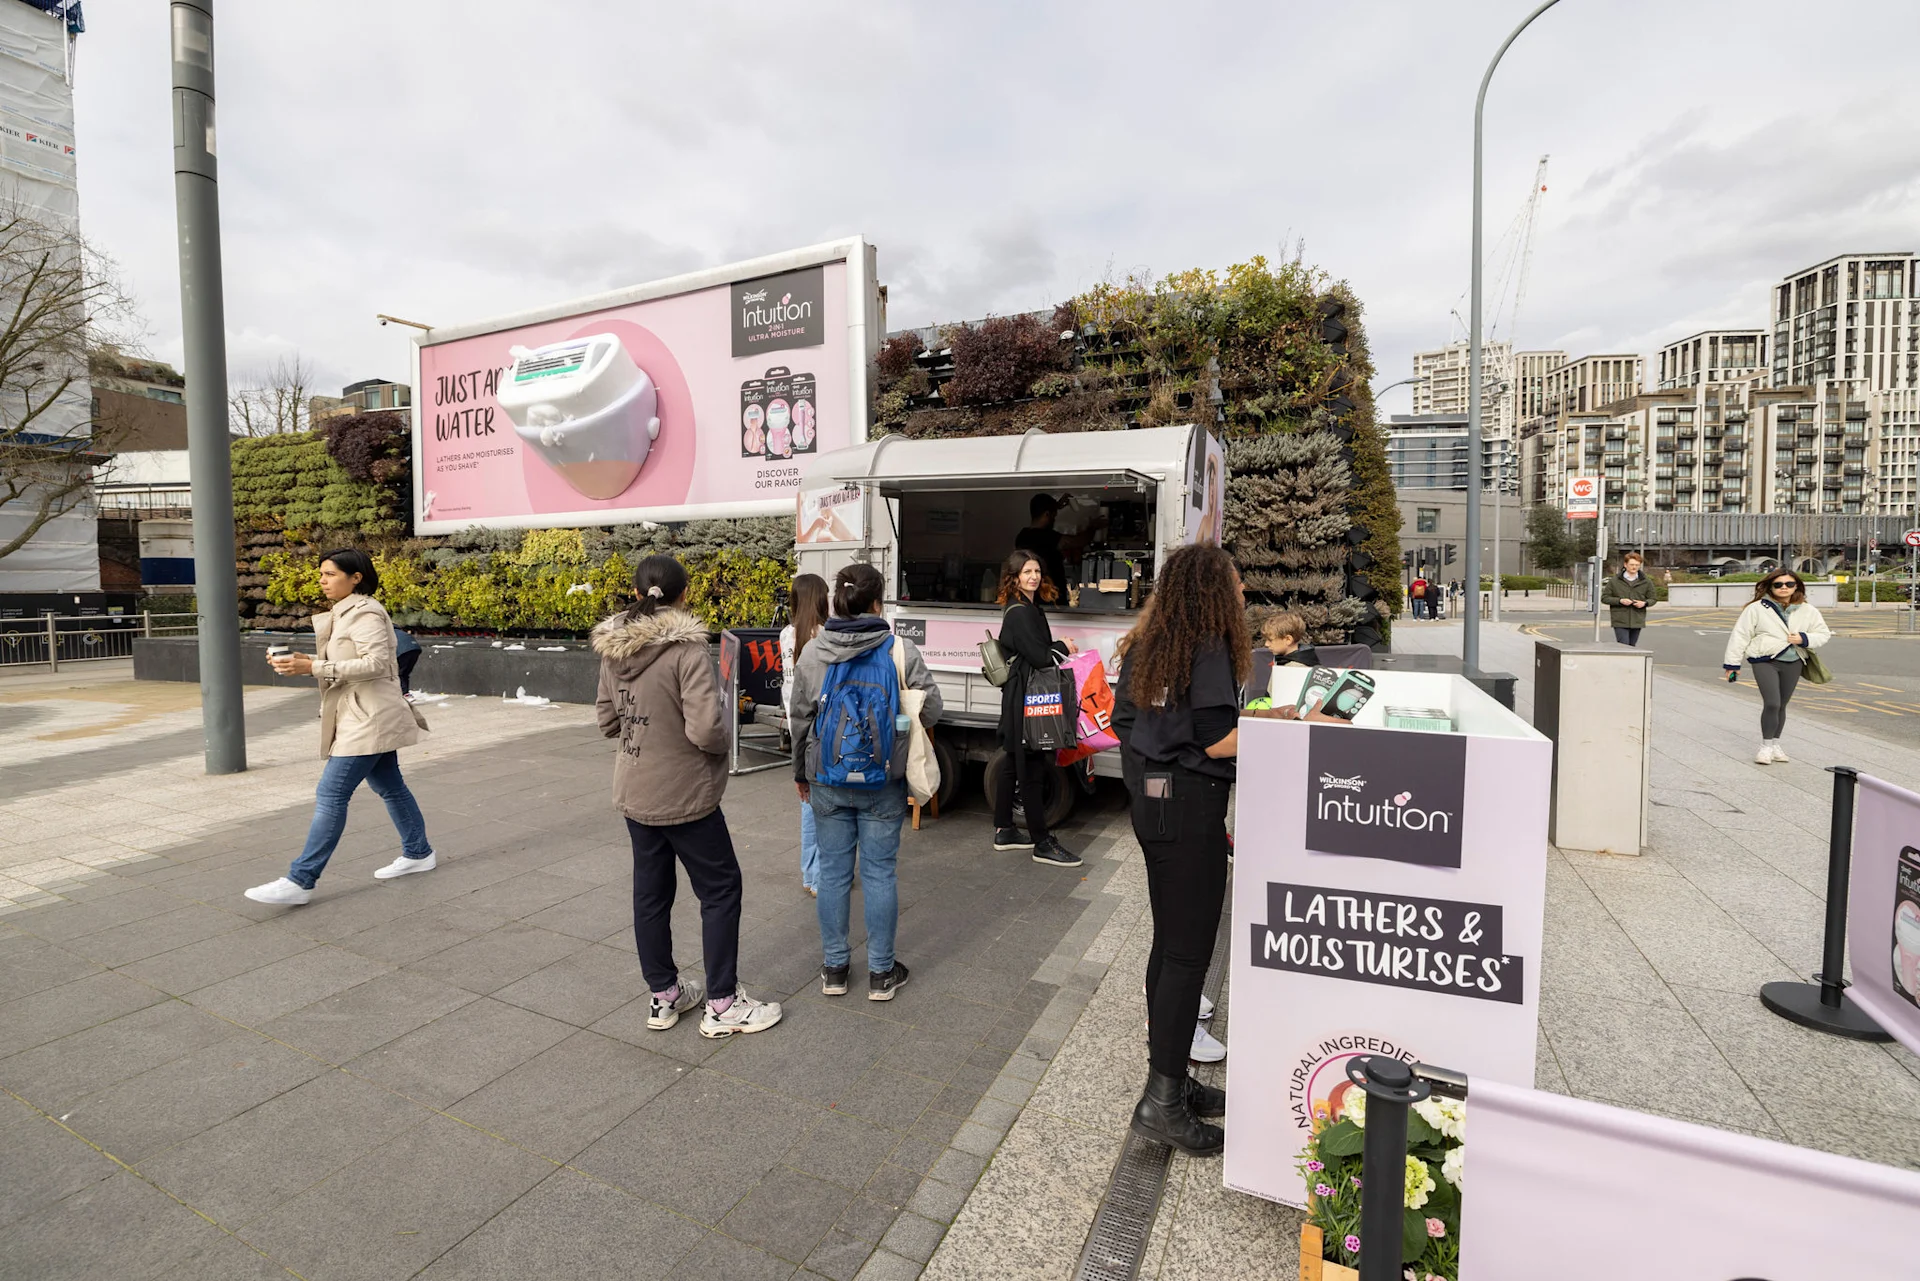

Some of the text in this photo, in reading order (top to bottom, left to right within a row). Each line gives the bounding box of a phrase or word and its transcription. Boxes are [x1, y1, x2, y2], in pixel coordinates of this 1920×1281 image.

[39, 138, 59, 150] KIER
[743, 301, 811, 328] Intuition
[748, 326, 805, 342] ULTRA MOISTURE
[435, 370, 481, 406] JUST
[436, 407, 495, 442] WATER
[437, 447, 514, 463] LATHERS AND MOISTURISES
[757, 468, 799, 478] DISCOVER
[755, 480, 772, 488] OUR
[1574, 484, 1592, 493] WG
[896, 626, 924, 637] Intuition
[618, 690, 635, 706] The
[1026, 694, 1060, 705] SPORTS
[1027, 706, 1060, 716] DIRECT
[1319, 776, 1364, 787] WILKINSON
[1318, 792, 1449, 833] Intuition
[1284, 890, 1483, 946] LATHERS &
[1319, 1036, 1420, 1063] INGREDIE
[1290, 1053, 1322, 1129] NATURAL
[1260, 1191, 1277, 1201] during
